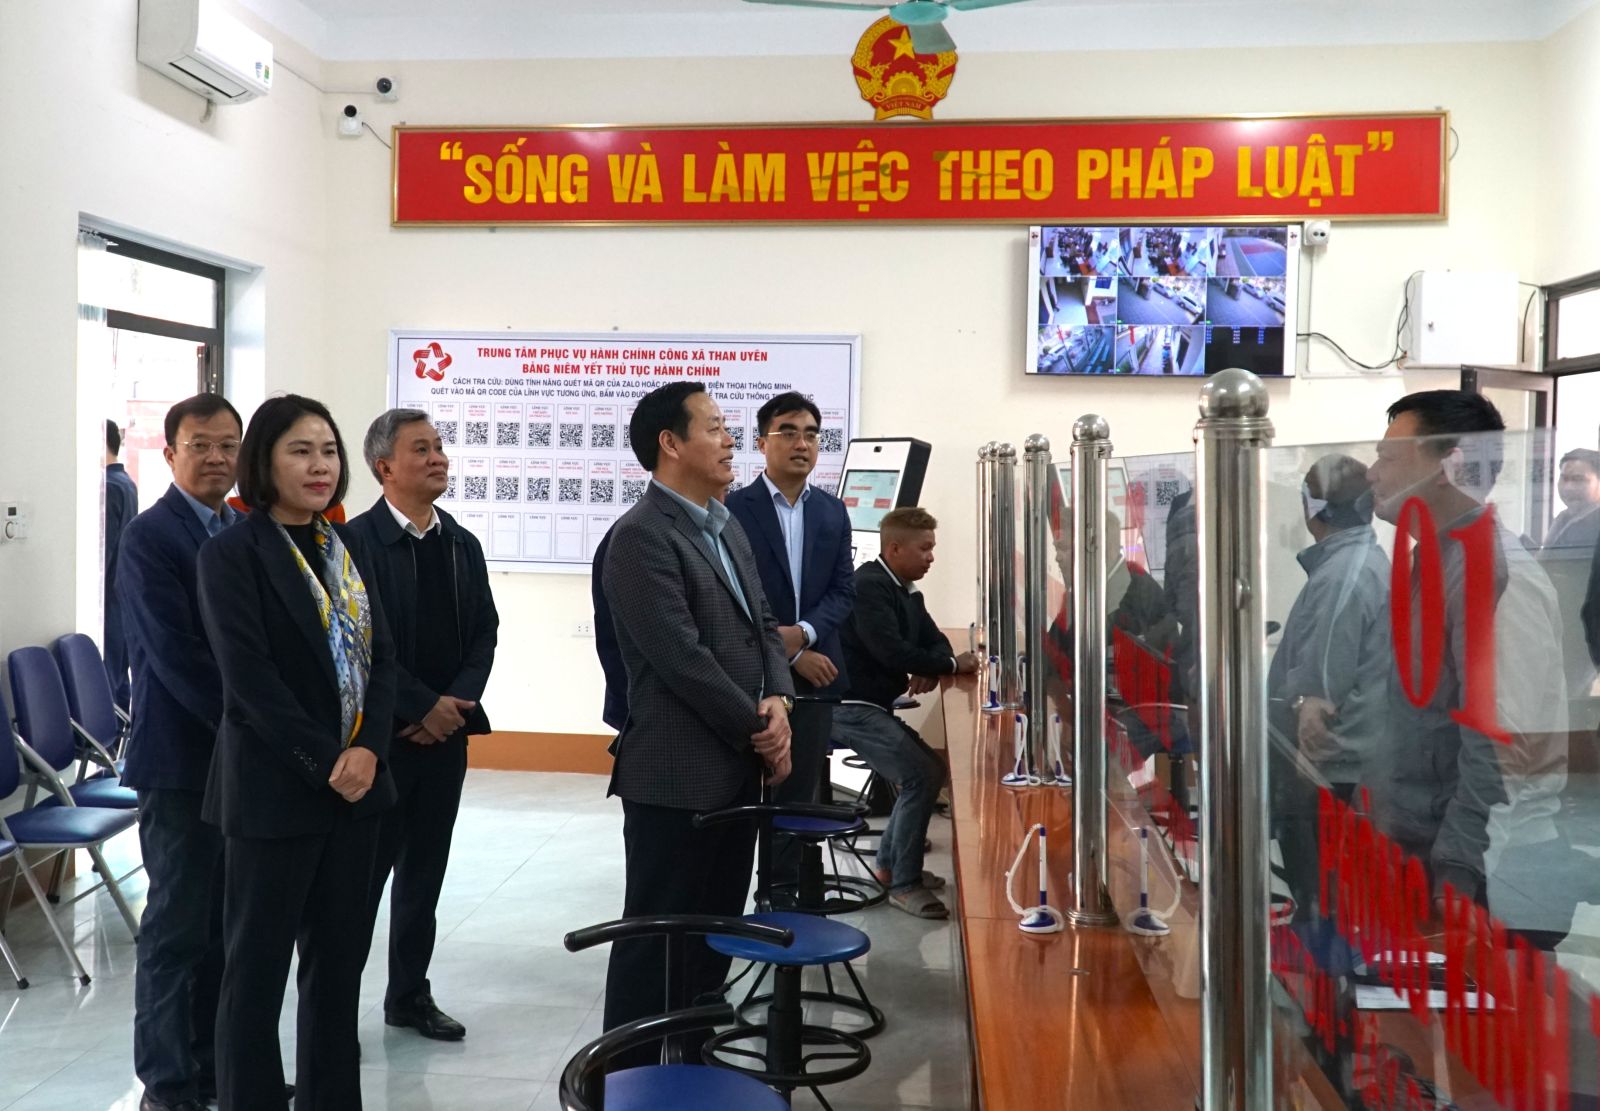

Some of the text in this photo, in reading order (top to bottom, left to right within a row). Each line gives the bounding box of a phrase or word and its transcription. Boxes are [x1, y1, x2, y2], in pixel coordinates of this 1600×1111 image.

[607, 142, 662, 203] VÀ
[683, 142, 786, 203] LÀM
[806, 140, 909, 212] VIỆC
[935, 148, 1054, 201] THEO
[1077, 136, 1214, 199] PHÁP
[477, 346, 768, 362] TRUNG TÂM PHỤC VỤ HÀNH CHÍNH CÔNG XÃ THAN UYÊN
[522, 361, 720, 377] BẢNG NIÊM YẾT THỦ TỤC HÀNH CHÍNH
[452, 377, 472, 386] CÁCH
[473, 378, 486, 386] TRA
[487, 376, 503, 386] CỨU:
[504, 377, 524, 387] DÙNG
[526, 378, 541, 387] TÍNH
[543, 378, 562, 387] NĂNG
[563, 379, 581, 387] QUÉT
[583, 379, 594, 388] MÃ
[595, 380, 605, 388] QR
[607, 379, 621, 388] CỦA
[622, 380, 640, 388] ZALO
[641, 380, 661, 389] HOẶC
[708, 380, 725, 390] ĐIỆN
[727, 382, 748, 390] THOẠI
[749, 381, 773, 391] THÔNG
[774, 383, 792, 391] MINH
[431, 387, 449, 396] QUÉT
[450, 387, 465, 396] VÀO
[465, 387, 477, 396] MÃ
[477, 389, 487, 397] QR
[489, 389, 507, 397] CODE
[508, 387, 523, 397] CỦA
[524, 388, 540, 397] LĨNH
[541, 389, 555, 399] VỰC
[556, 389, 580, 398] TƯƠNG
[599, 389, 614, 399] BẤM
[616, 390, 630, 399] VÀO
[715, 392, 729, 401] TRA
[731, 391, 745, 401] CỨU
[747, 391, 770, 401] THÔNG
[1391, 496, 1514, 745] 01
